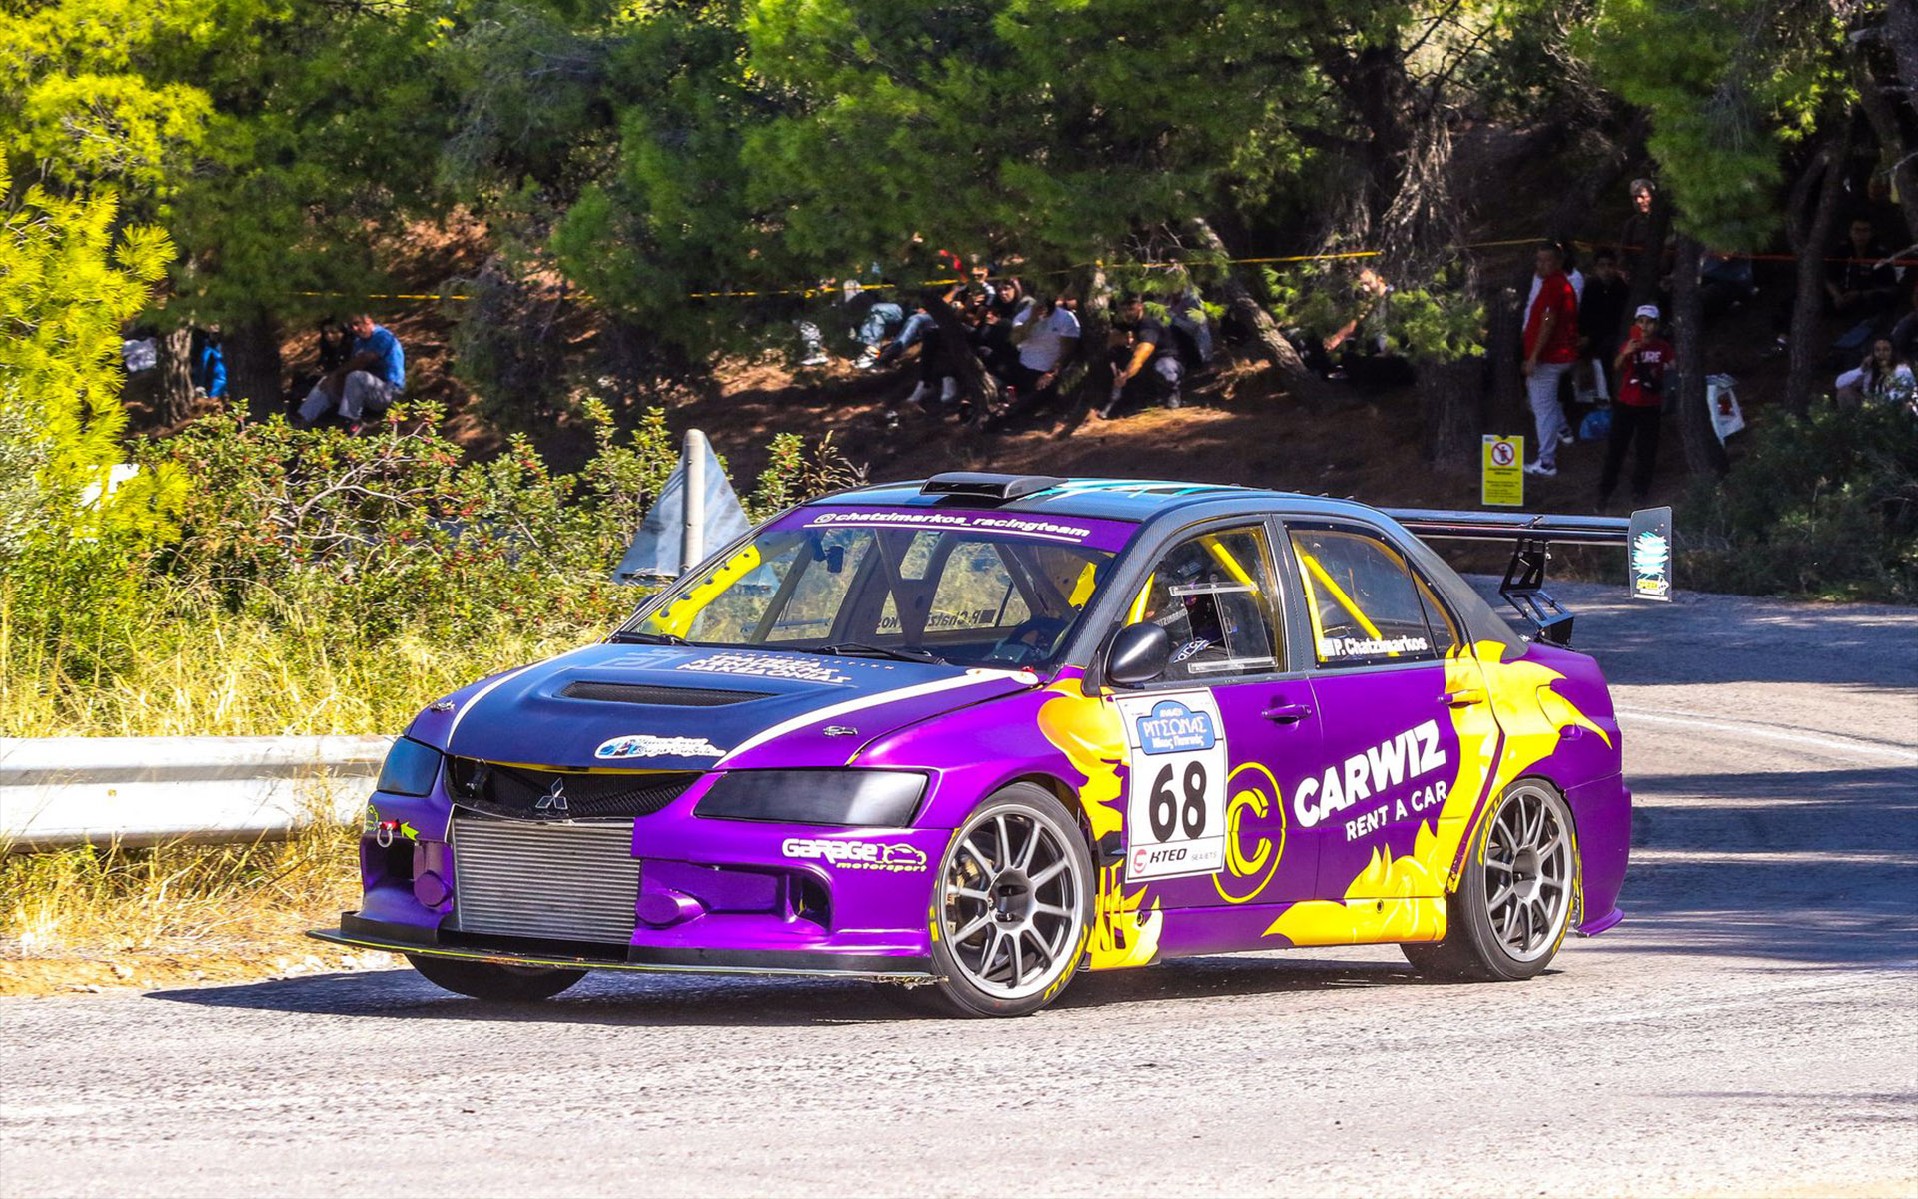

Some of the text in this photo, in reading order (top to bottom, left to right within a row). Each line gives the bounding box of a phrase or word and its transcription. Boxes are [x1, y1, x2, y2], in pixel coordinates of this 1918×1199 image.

[1149, 761, 1207, 843] 68
[1294, 719, 1446, 828] CARWIZ
[1345, 780, 1447, 842] RENT A CAR
[836, 862, 927, 873] motorsport
